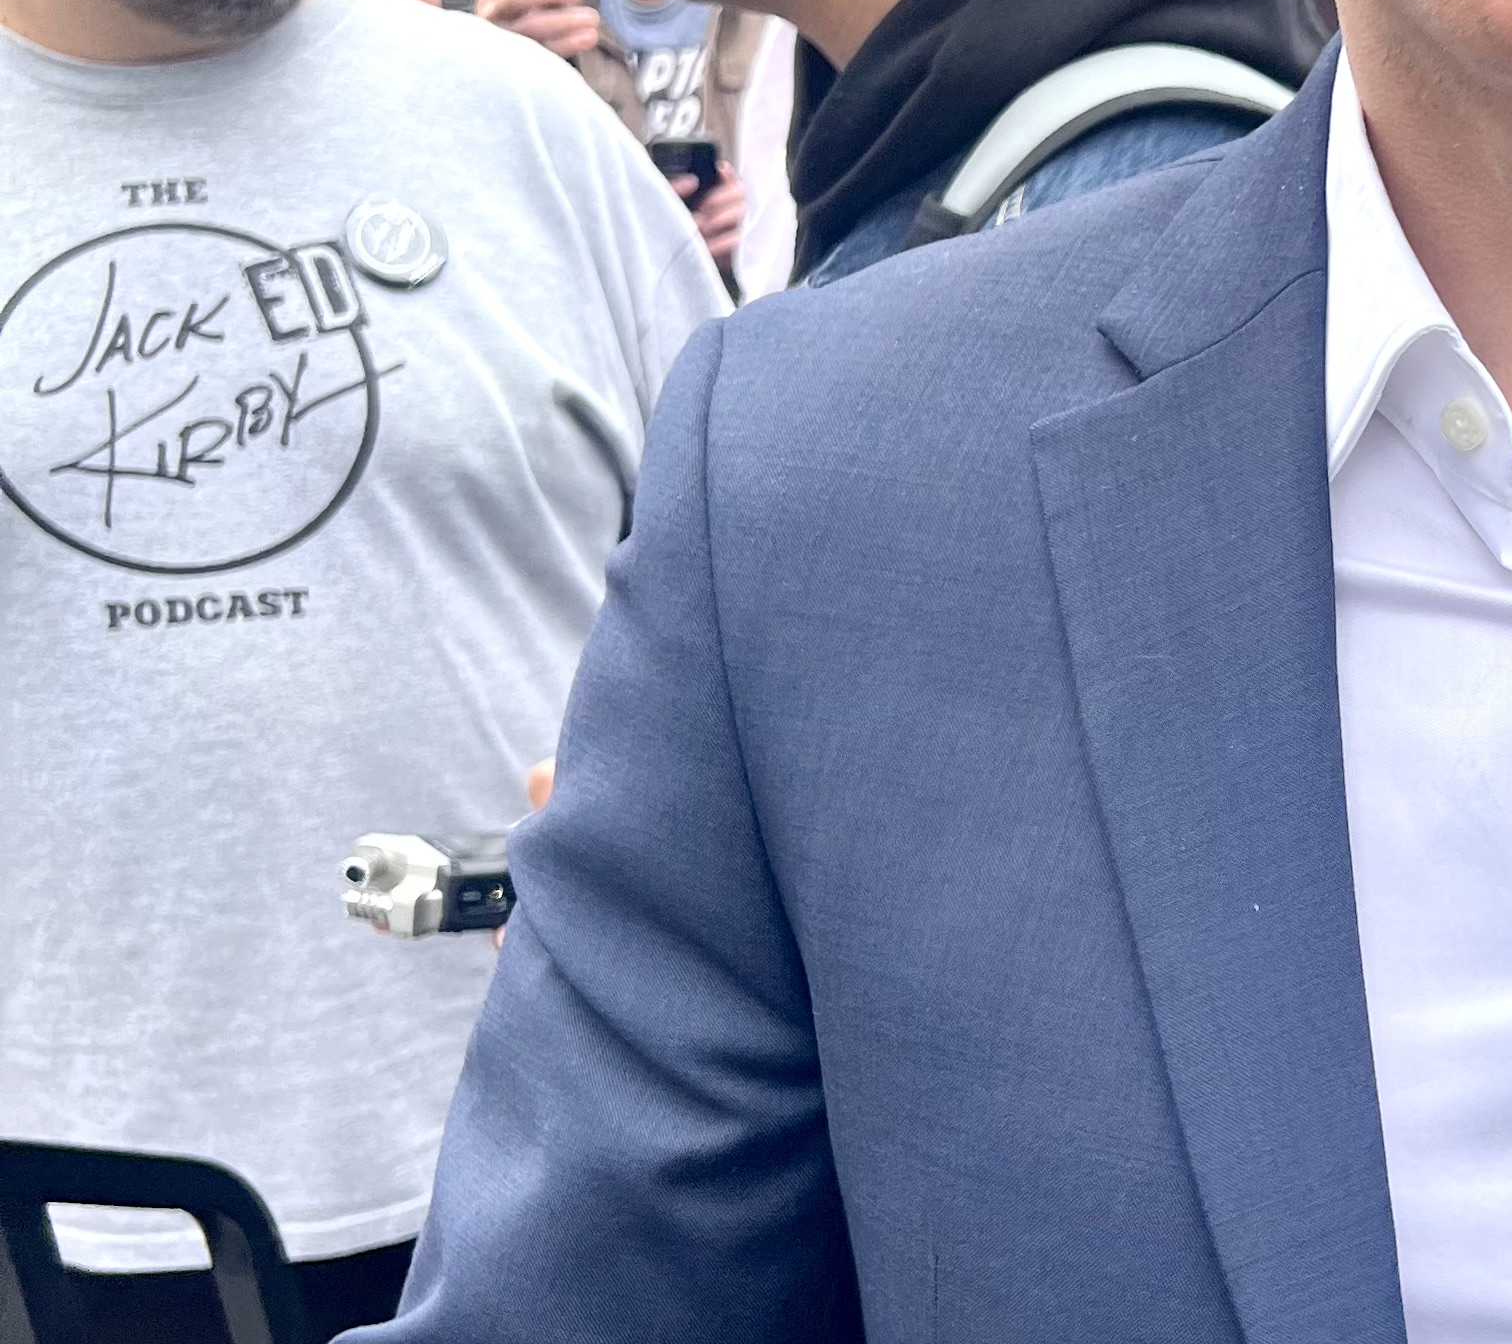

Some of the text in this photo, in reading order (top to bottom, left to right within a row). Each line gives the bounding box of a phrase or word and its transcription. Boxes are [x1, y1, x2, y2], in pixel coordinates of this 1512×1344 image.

[121, 177, 209, 207] THE
[49, 351, 406, 530] KIRBY
[106, 588, 310, 633] PODCAST
